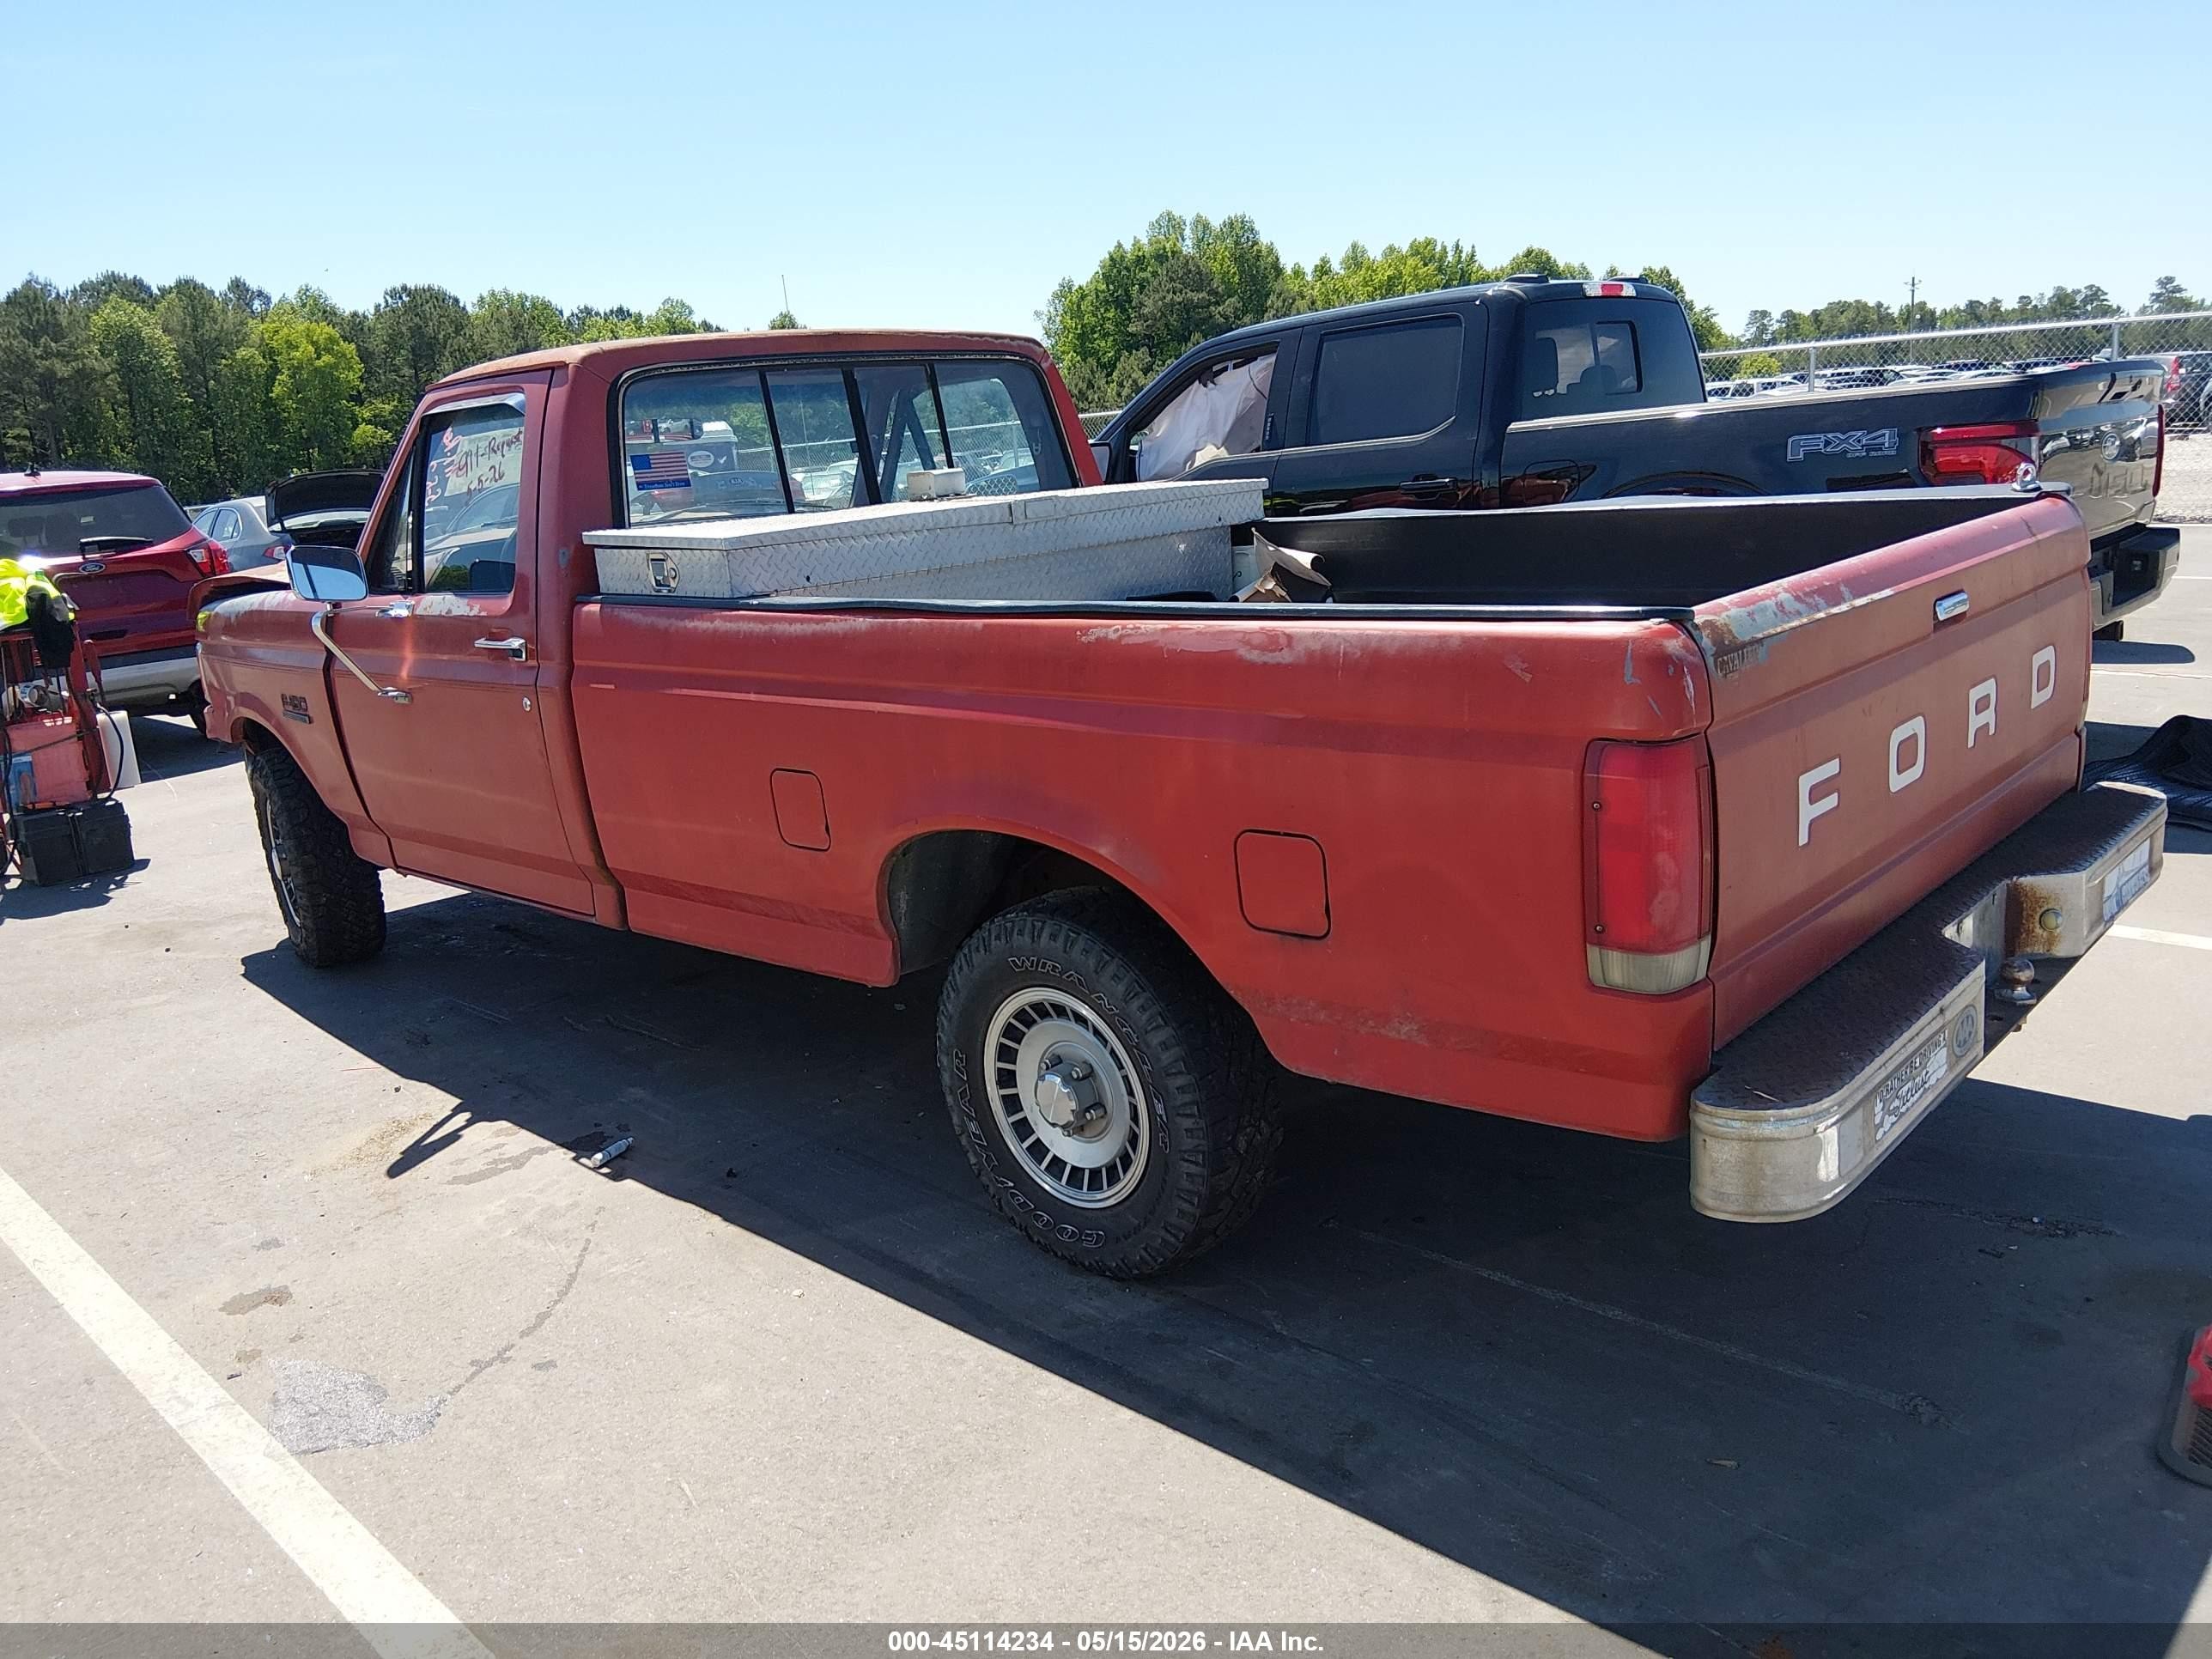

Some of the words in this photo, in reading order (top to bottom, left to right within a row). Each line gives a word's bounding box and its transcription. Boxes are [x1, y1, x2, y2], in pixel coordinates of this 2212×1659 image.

[1787, 428, 1899, 462] FX4
[1799, 645, 2057, 847] FORD
[953, 1049, 1106, 1248] GOODYEAR
[1008, 956, 1170, 1154] WRANGLER
